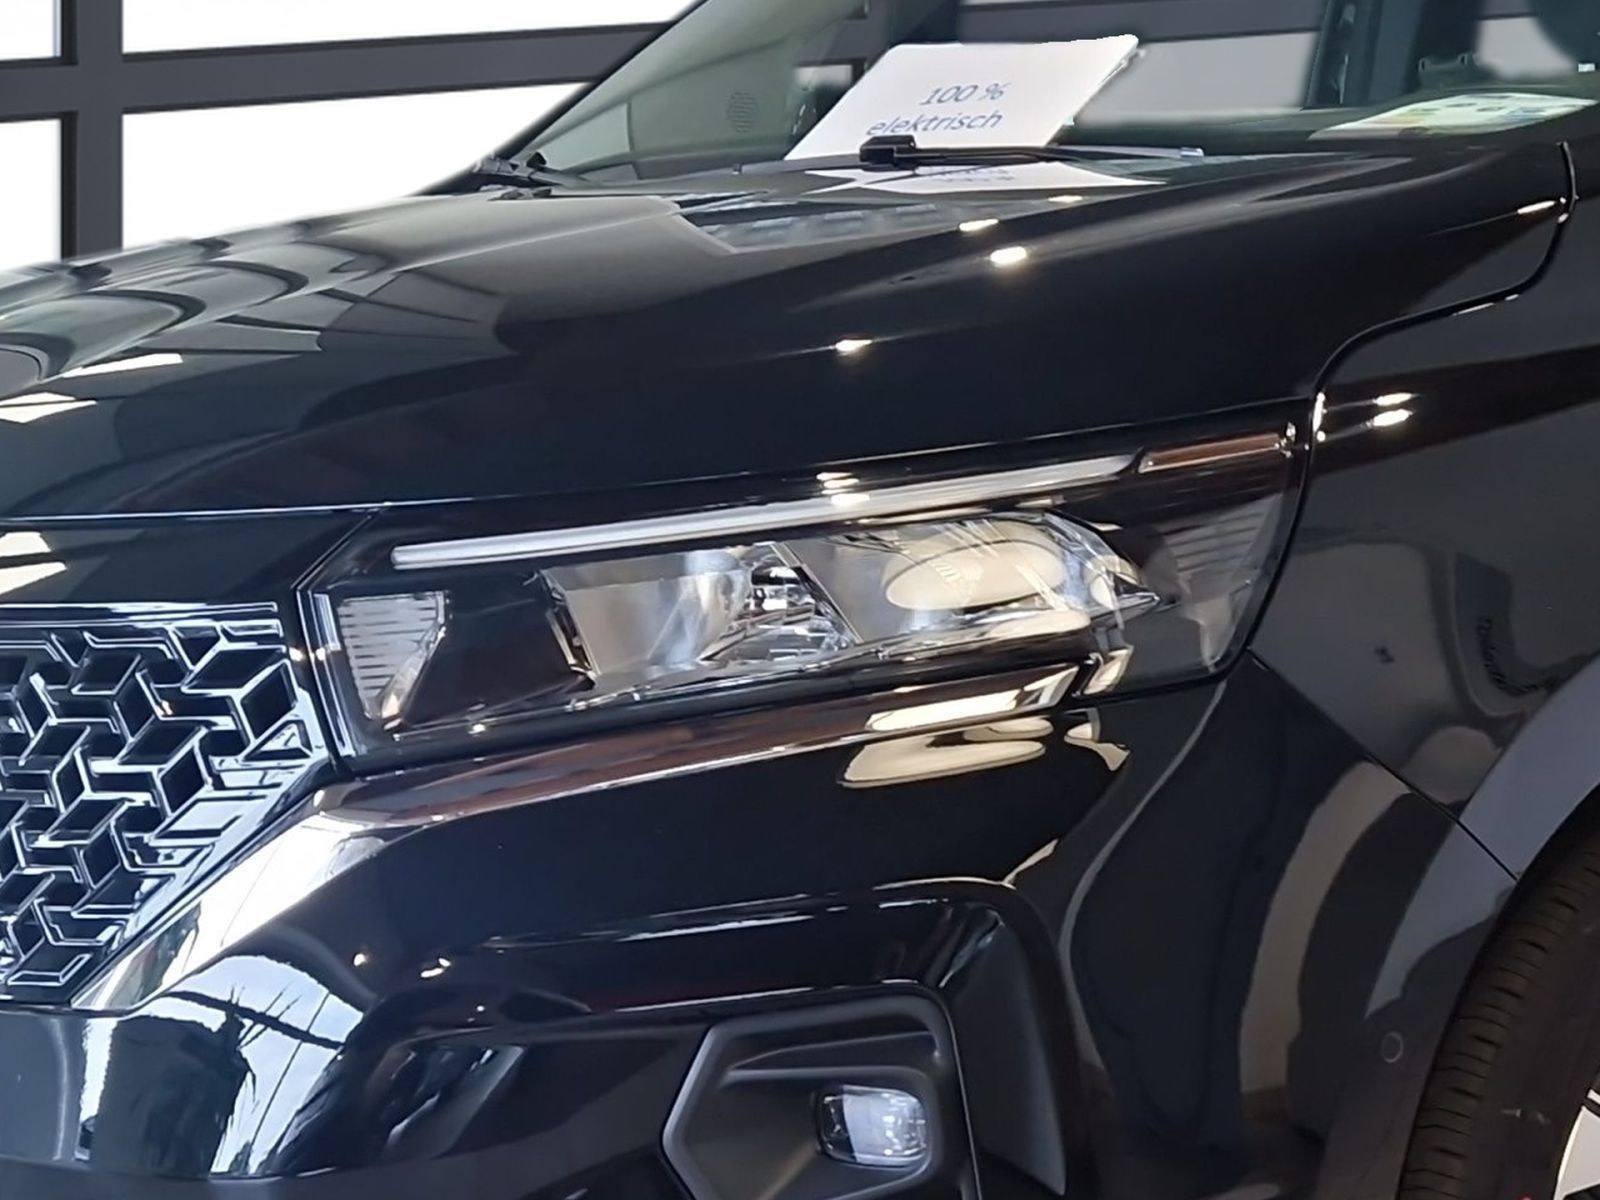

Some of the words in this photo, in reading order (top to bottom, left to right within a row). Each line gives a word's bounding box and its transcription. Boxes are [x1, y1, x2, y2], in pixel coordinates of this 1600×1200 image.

[919, 84, 979, 105] 100
[977, 82, 1011, 101] %
[865, 109, 1003, 135] elektrisch
